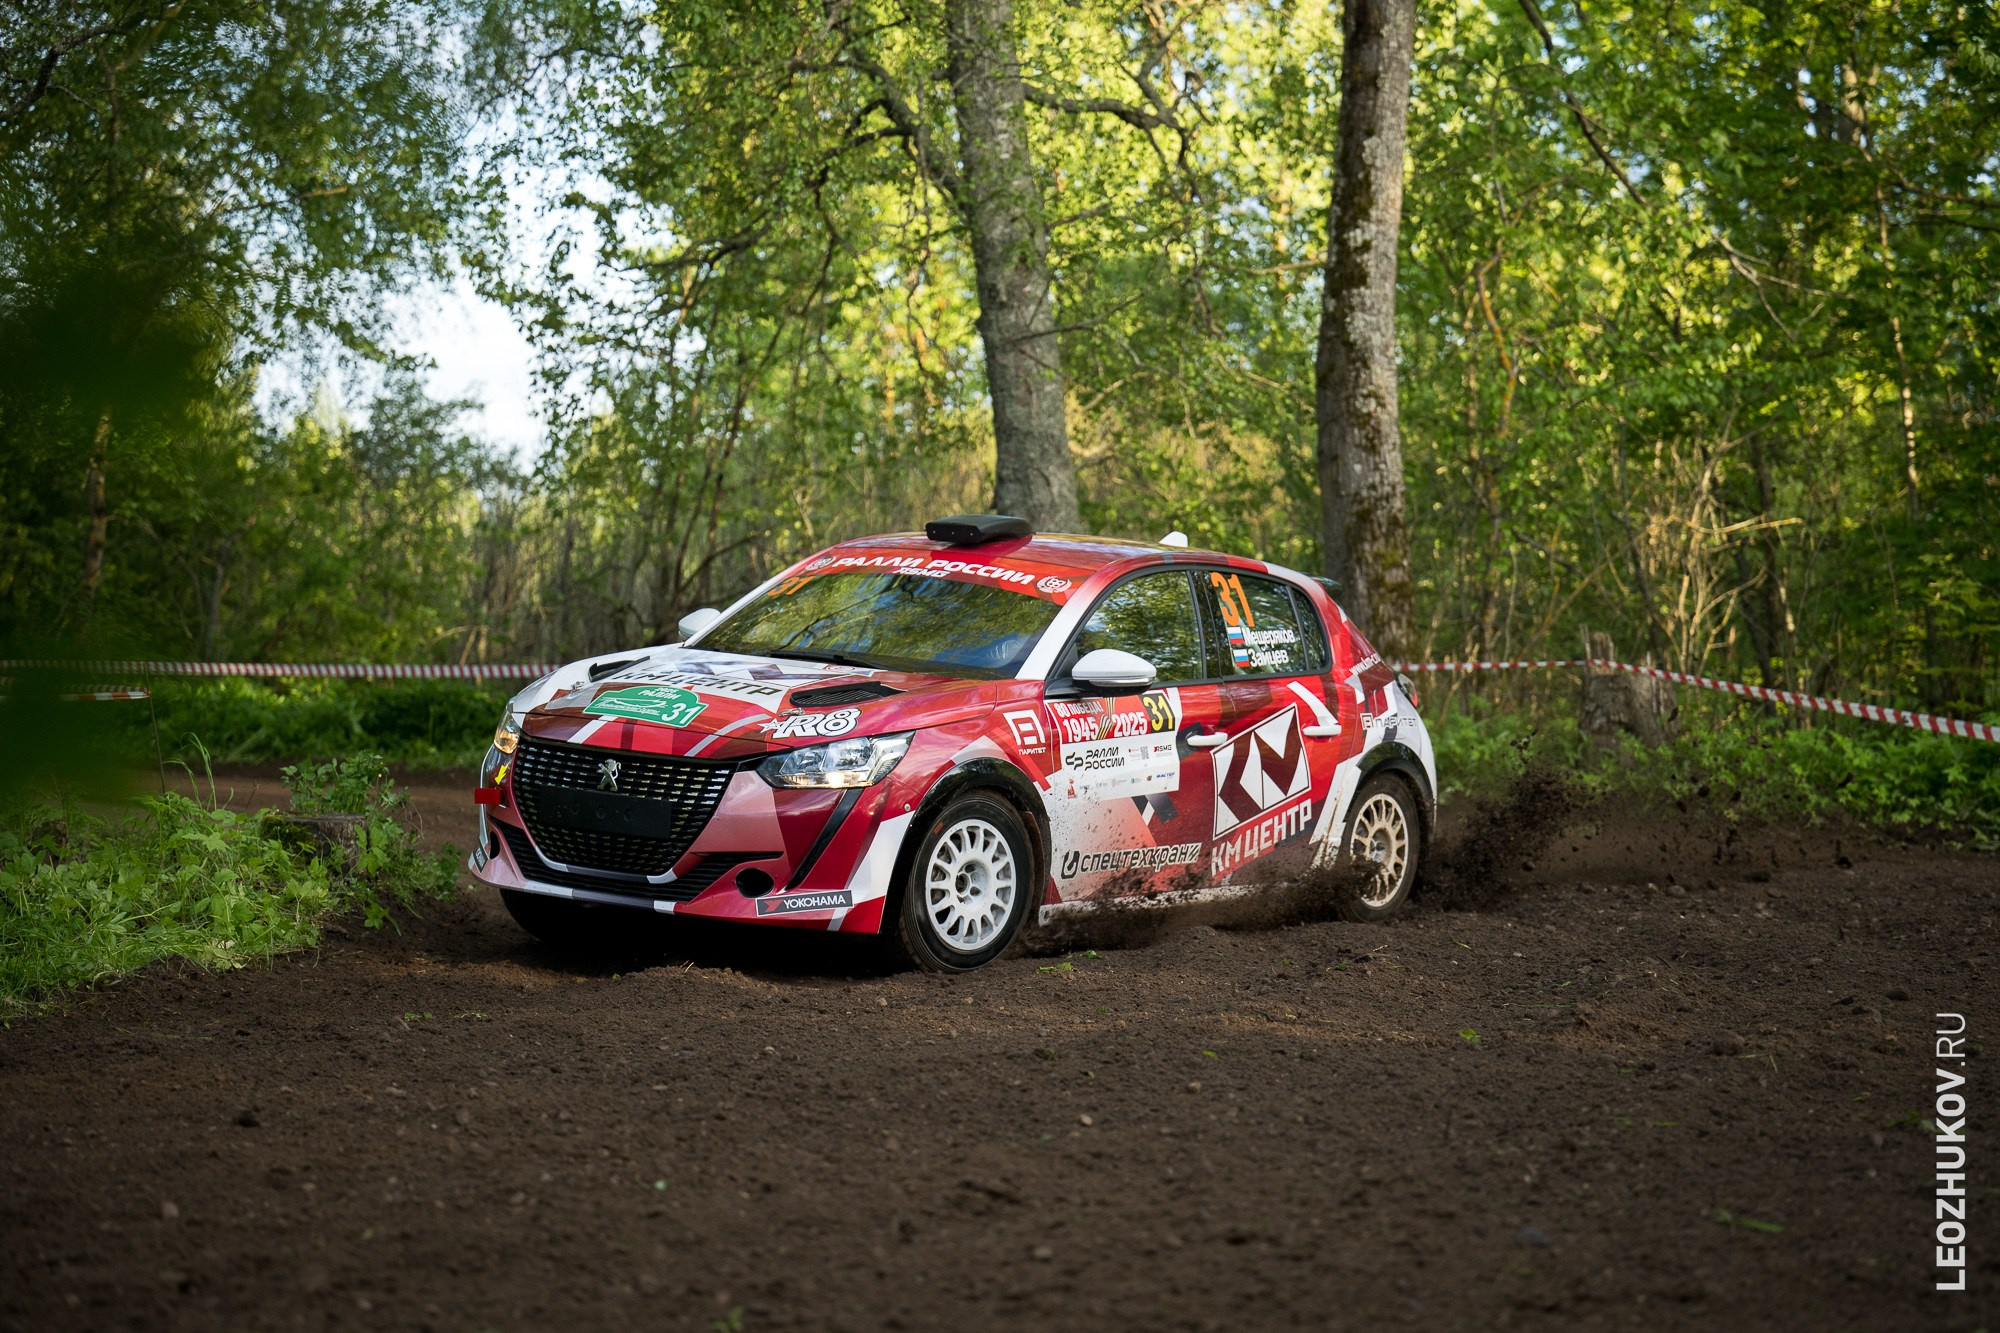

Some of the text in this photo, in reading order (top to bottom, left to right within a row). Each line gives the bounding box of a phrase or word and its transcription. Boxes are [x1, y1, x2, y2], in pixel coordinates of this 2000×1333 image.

[832, 556, 1035, 585] РАЛЛИ РОССИИ
[768, 576, 814, 597] 31
[1210, 572, 1255, 627] 31
[661, 702, 702, 725] 31
[1054, 703, 1071, 718] 80
[1143, 695, 1173, 732] 31
[1062, 712, 1148, 742] 1945 2025
[1018, 746, 1046, 755] ПАРИТЕТ
[1085, 746, 1119, 760] РАЛЛИ
[1085, 757, 1125, 771] РОССИИ
[783, 895, 846, 909] YOKOHAMA
